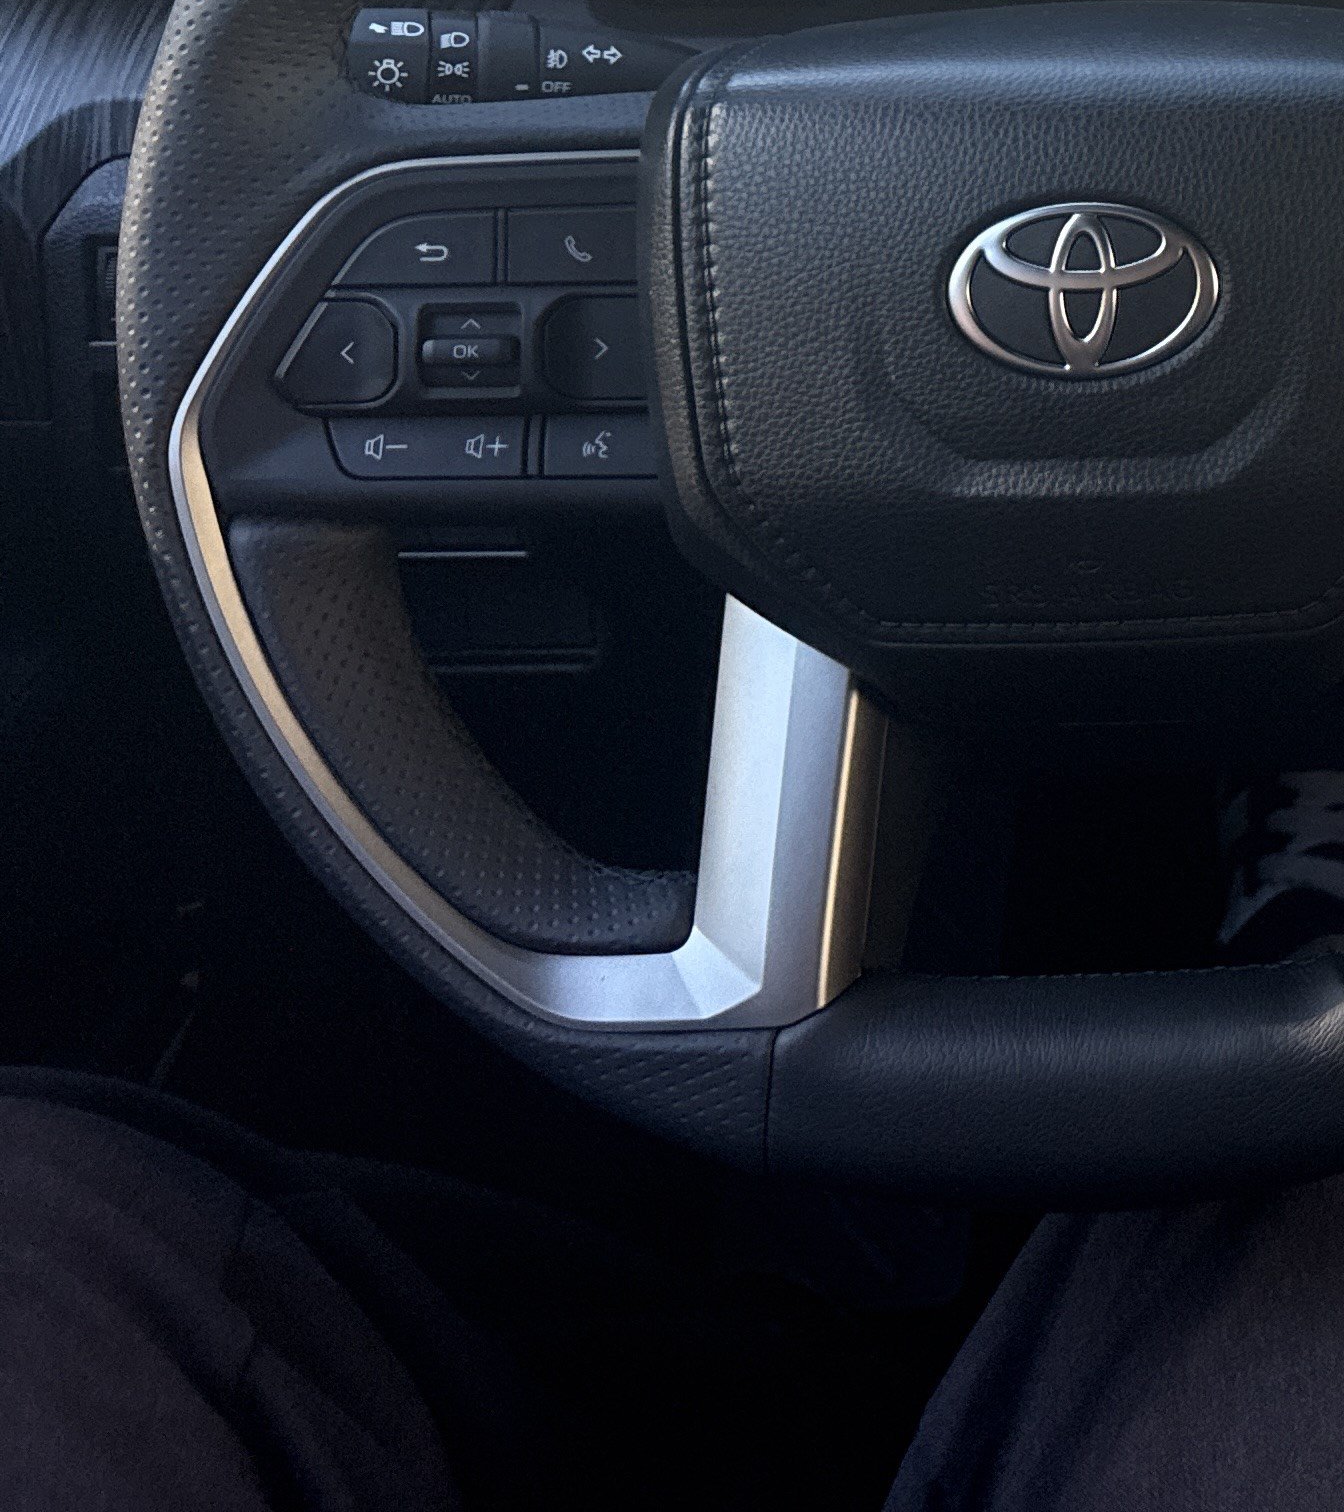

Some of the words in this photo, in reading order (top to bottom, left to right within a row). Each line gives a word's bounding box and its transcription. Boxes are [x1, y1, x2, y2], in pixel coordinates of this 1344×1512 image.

[541, 81, 572, 93] OFF
[431, 93, 473, 104] AUTO
[453, 345, 479, 359] OK
